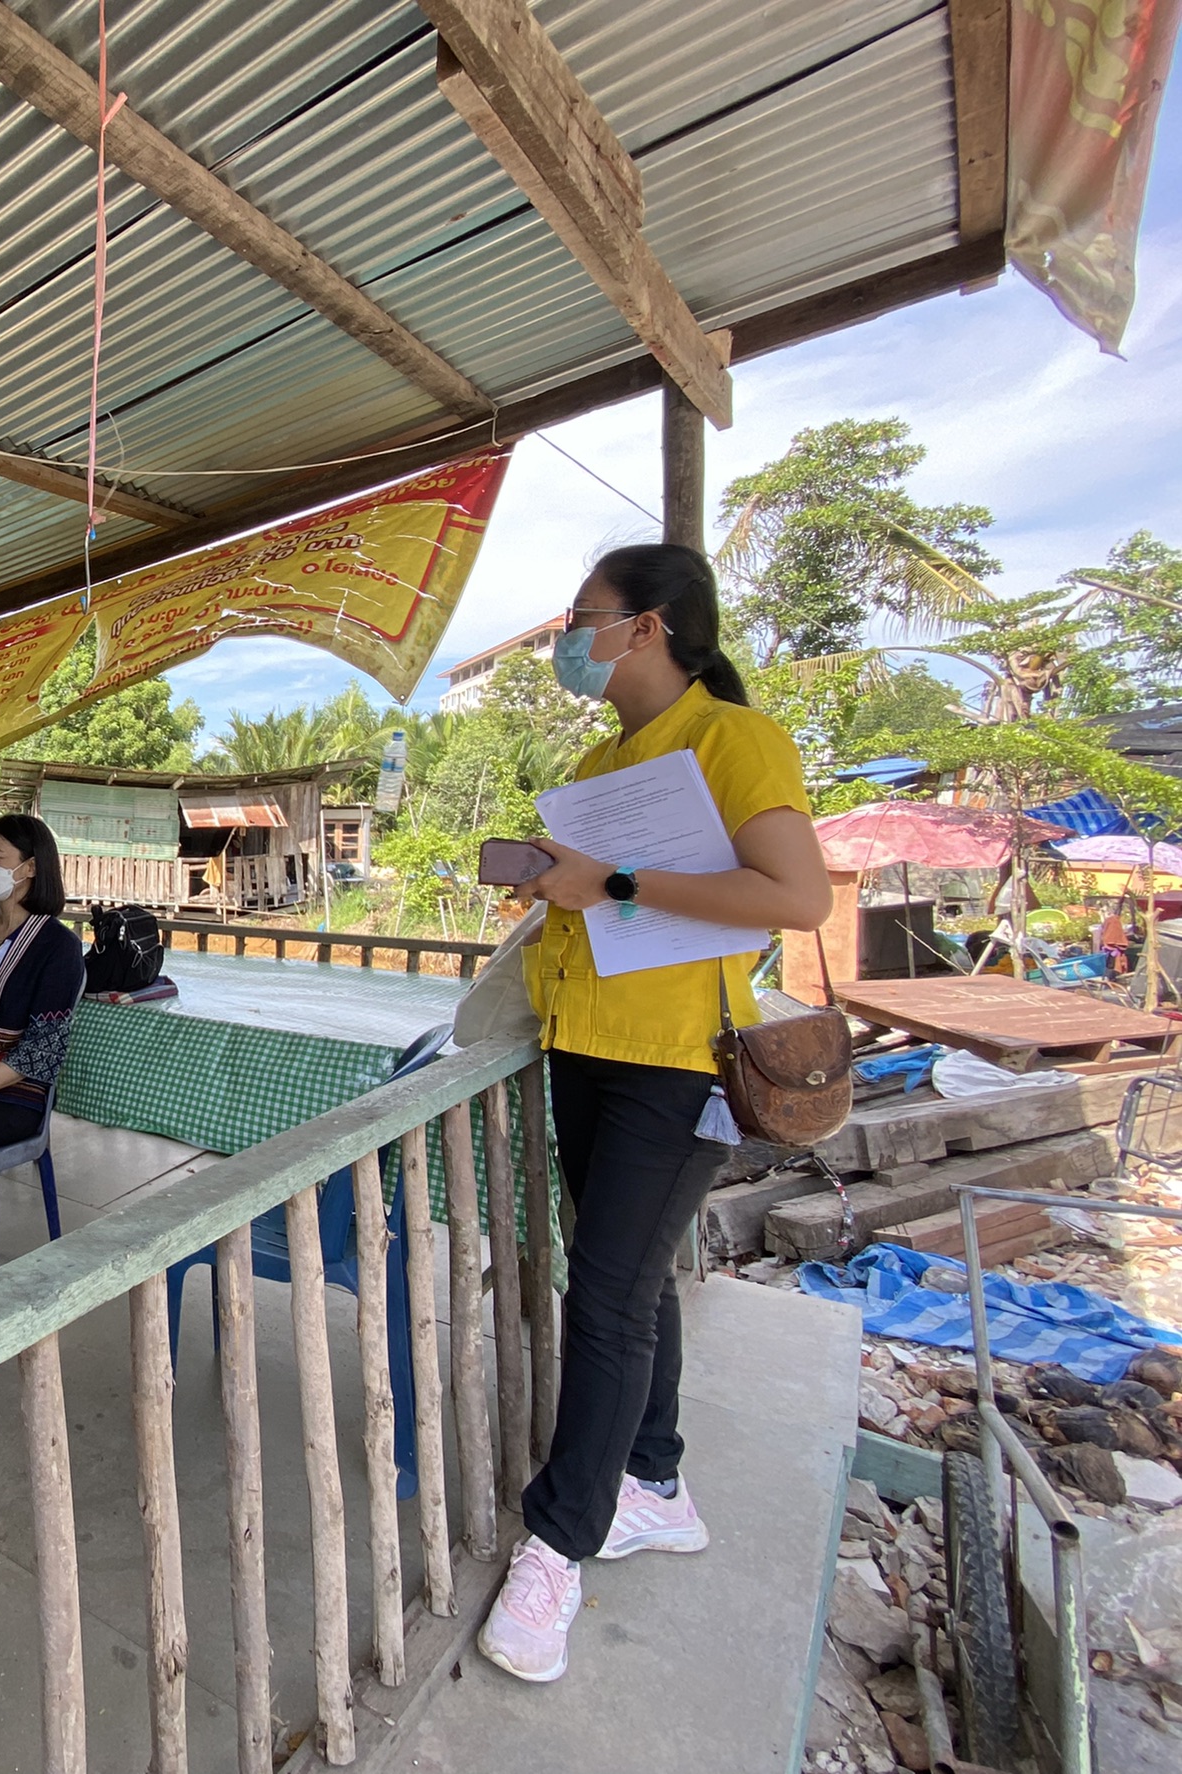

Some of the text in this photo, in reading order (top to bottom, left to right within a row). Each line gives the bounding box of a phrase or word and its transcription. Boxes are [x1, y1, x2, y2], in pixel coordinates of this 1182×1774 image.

[303, 533, 364, 553] บาท
[16, 642, 38, 656] บาท
[2, 670, 25, 683] บาท
